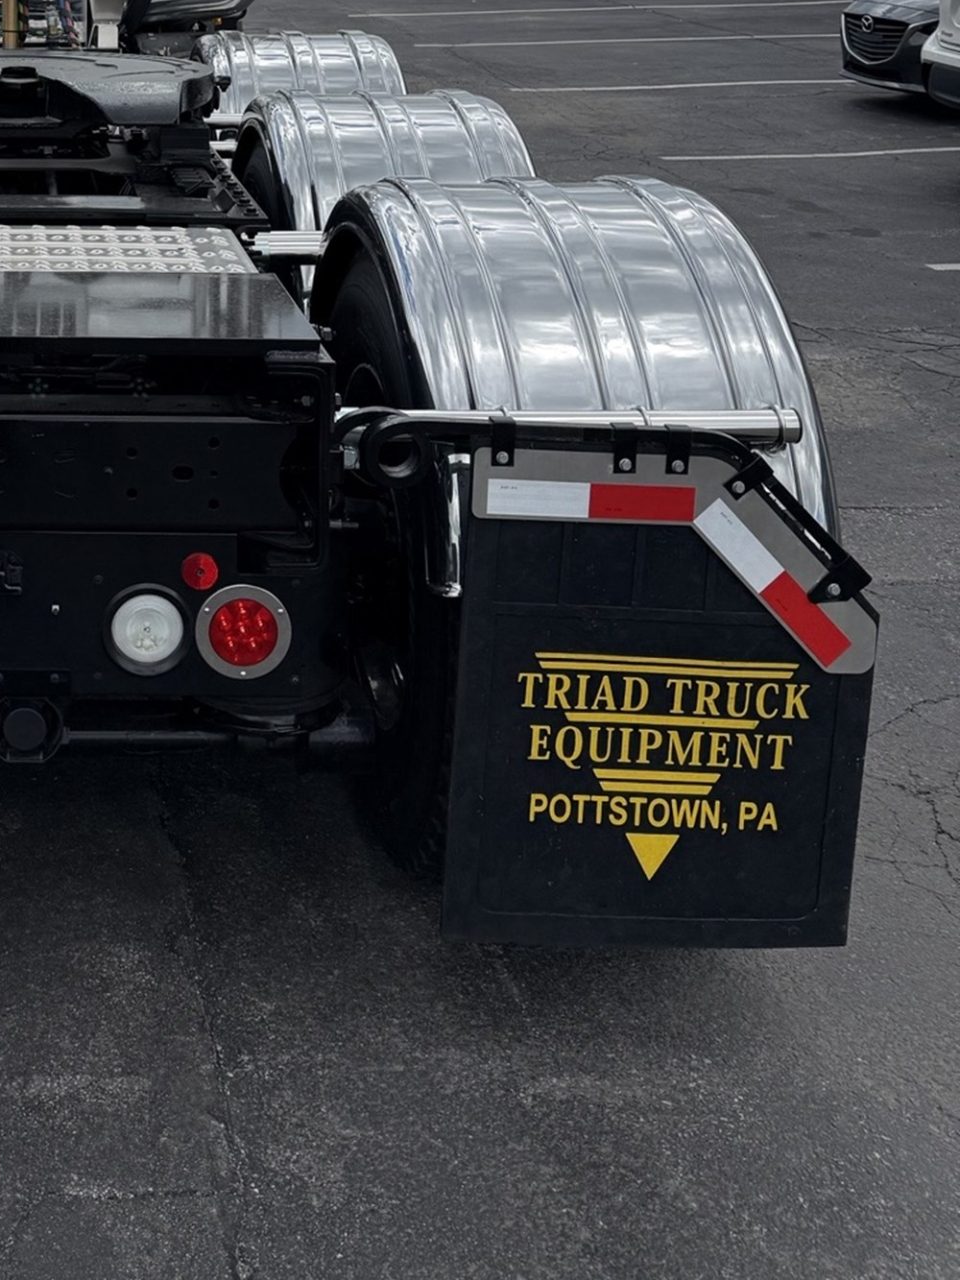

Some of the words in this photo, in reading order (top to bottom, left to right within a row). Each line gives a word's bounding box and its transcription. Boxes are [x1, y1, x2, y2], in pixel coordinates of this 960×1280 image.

[517, 671, 650, 712] TRIAD
[666, 678, 810, 720] TRUCK
[526, 724, 793, 771] EQUIPMENT
[528, 791, 730, 836] POTTSTOWN,
[738, 801, 778, 831] PA
